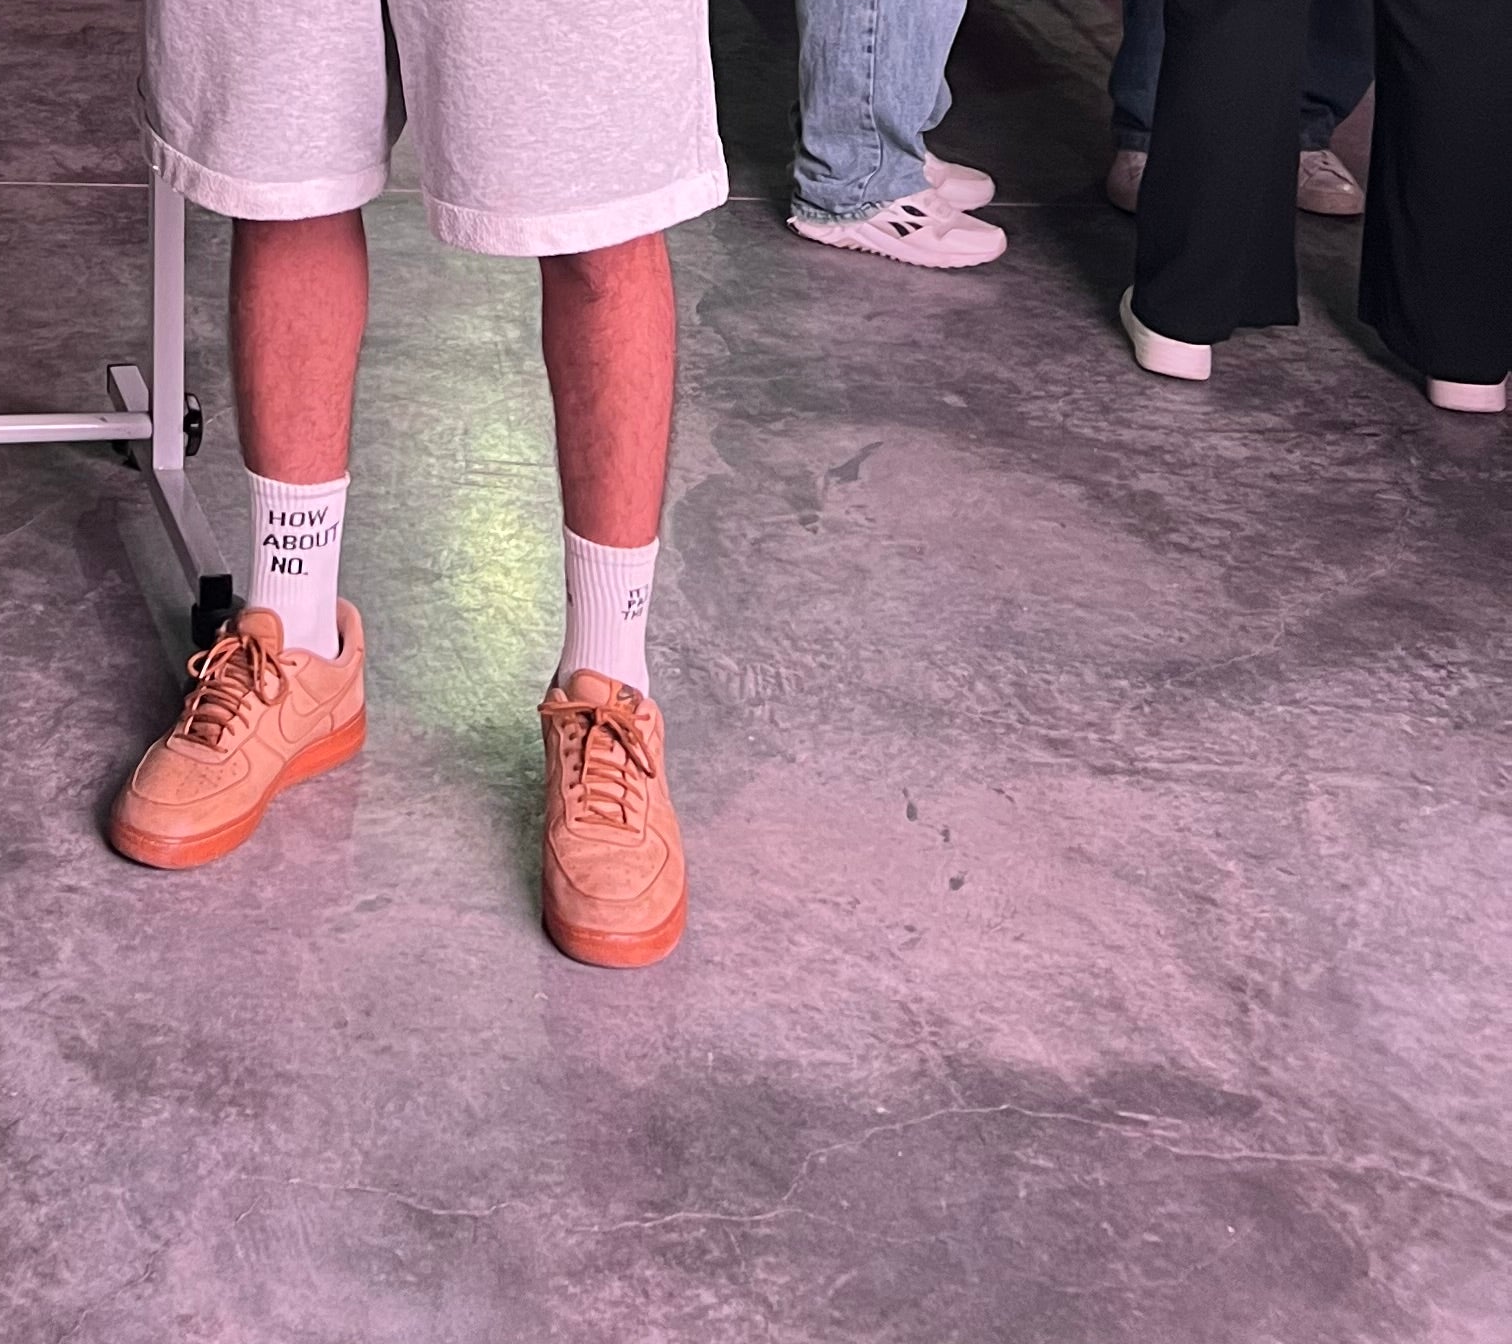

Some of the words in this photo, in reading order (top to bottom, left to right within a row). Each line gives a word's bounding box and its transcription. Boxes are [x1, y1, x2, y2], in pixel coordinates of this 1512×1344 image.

[268, 505, 329, 528] HOW
[262, 520, 340, 551] ABOUT
[270, 555, 309, 576] NO.
